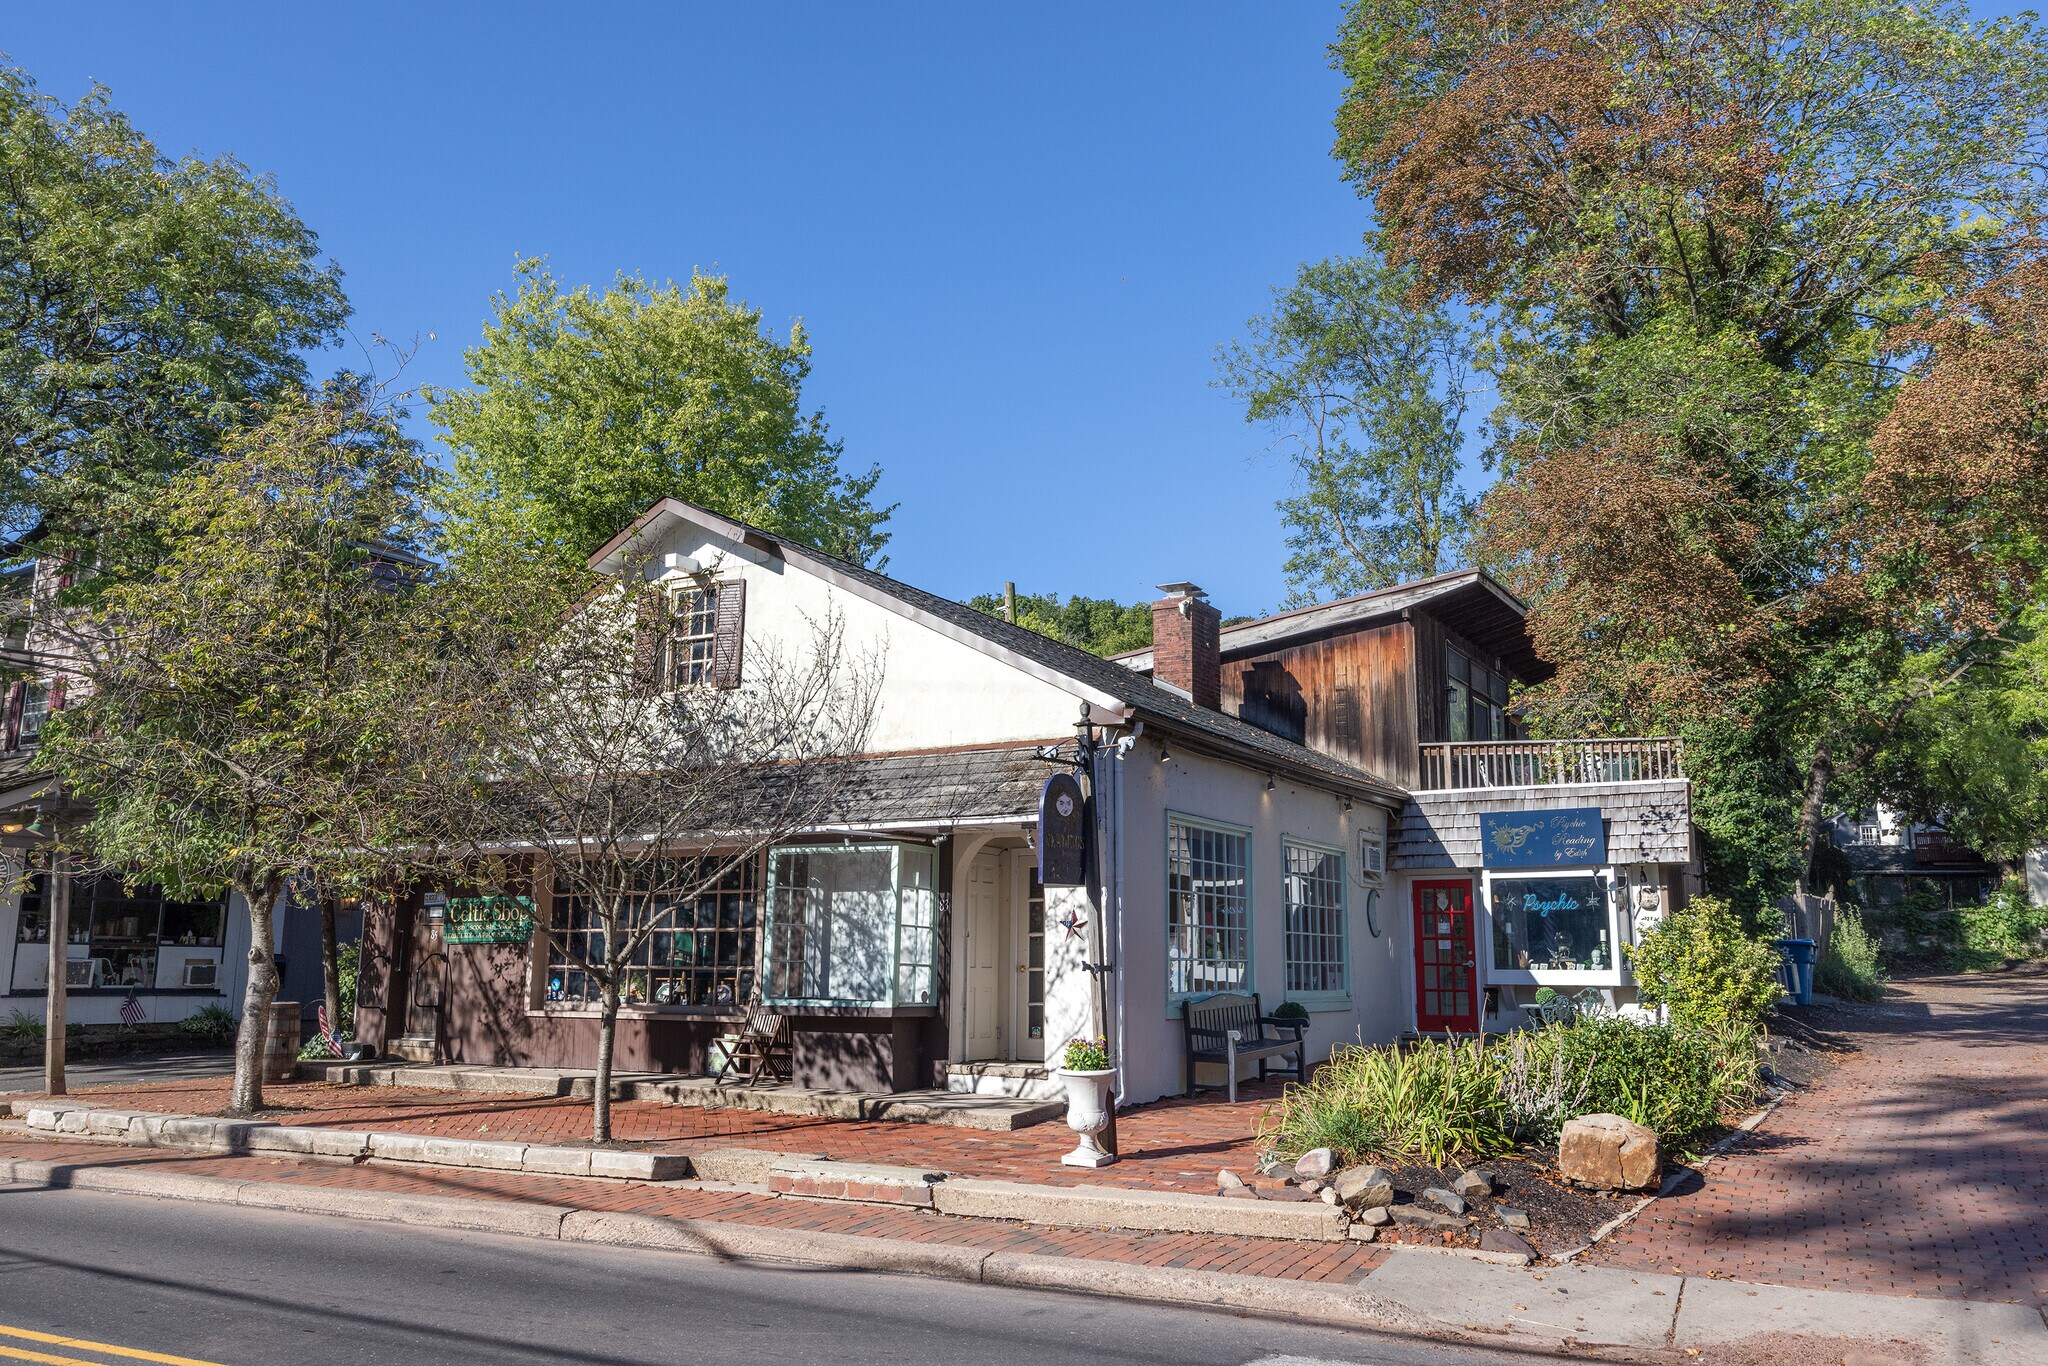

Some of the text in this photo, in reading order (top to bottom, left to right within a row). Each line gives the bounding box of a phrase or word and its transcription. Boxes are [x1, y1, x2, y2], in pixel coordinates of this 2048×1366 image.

[1551, 816, 1585, 832] Psychic
[1552, 833, 1596, 848] Reading
[1554, 850, 1562, 860] by
[1523, 893, 1579, 917] Psychic
[451, 902, 528, 926] Celtic Shop
[430, 929, 438, 941] 85
